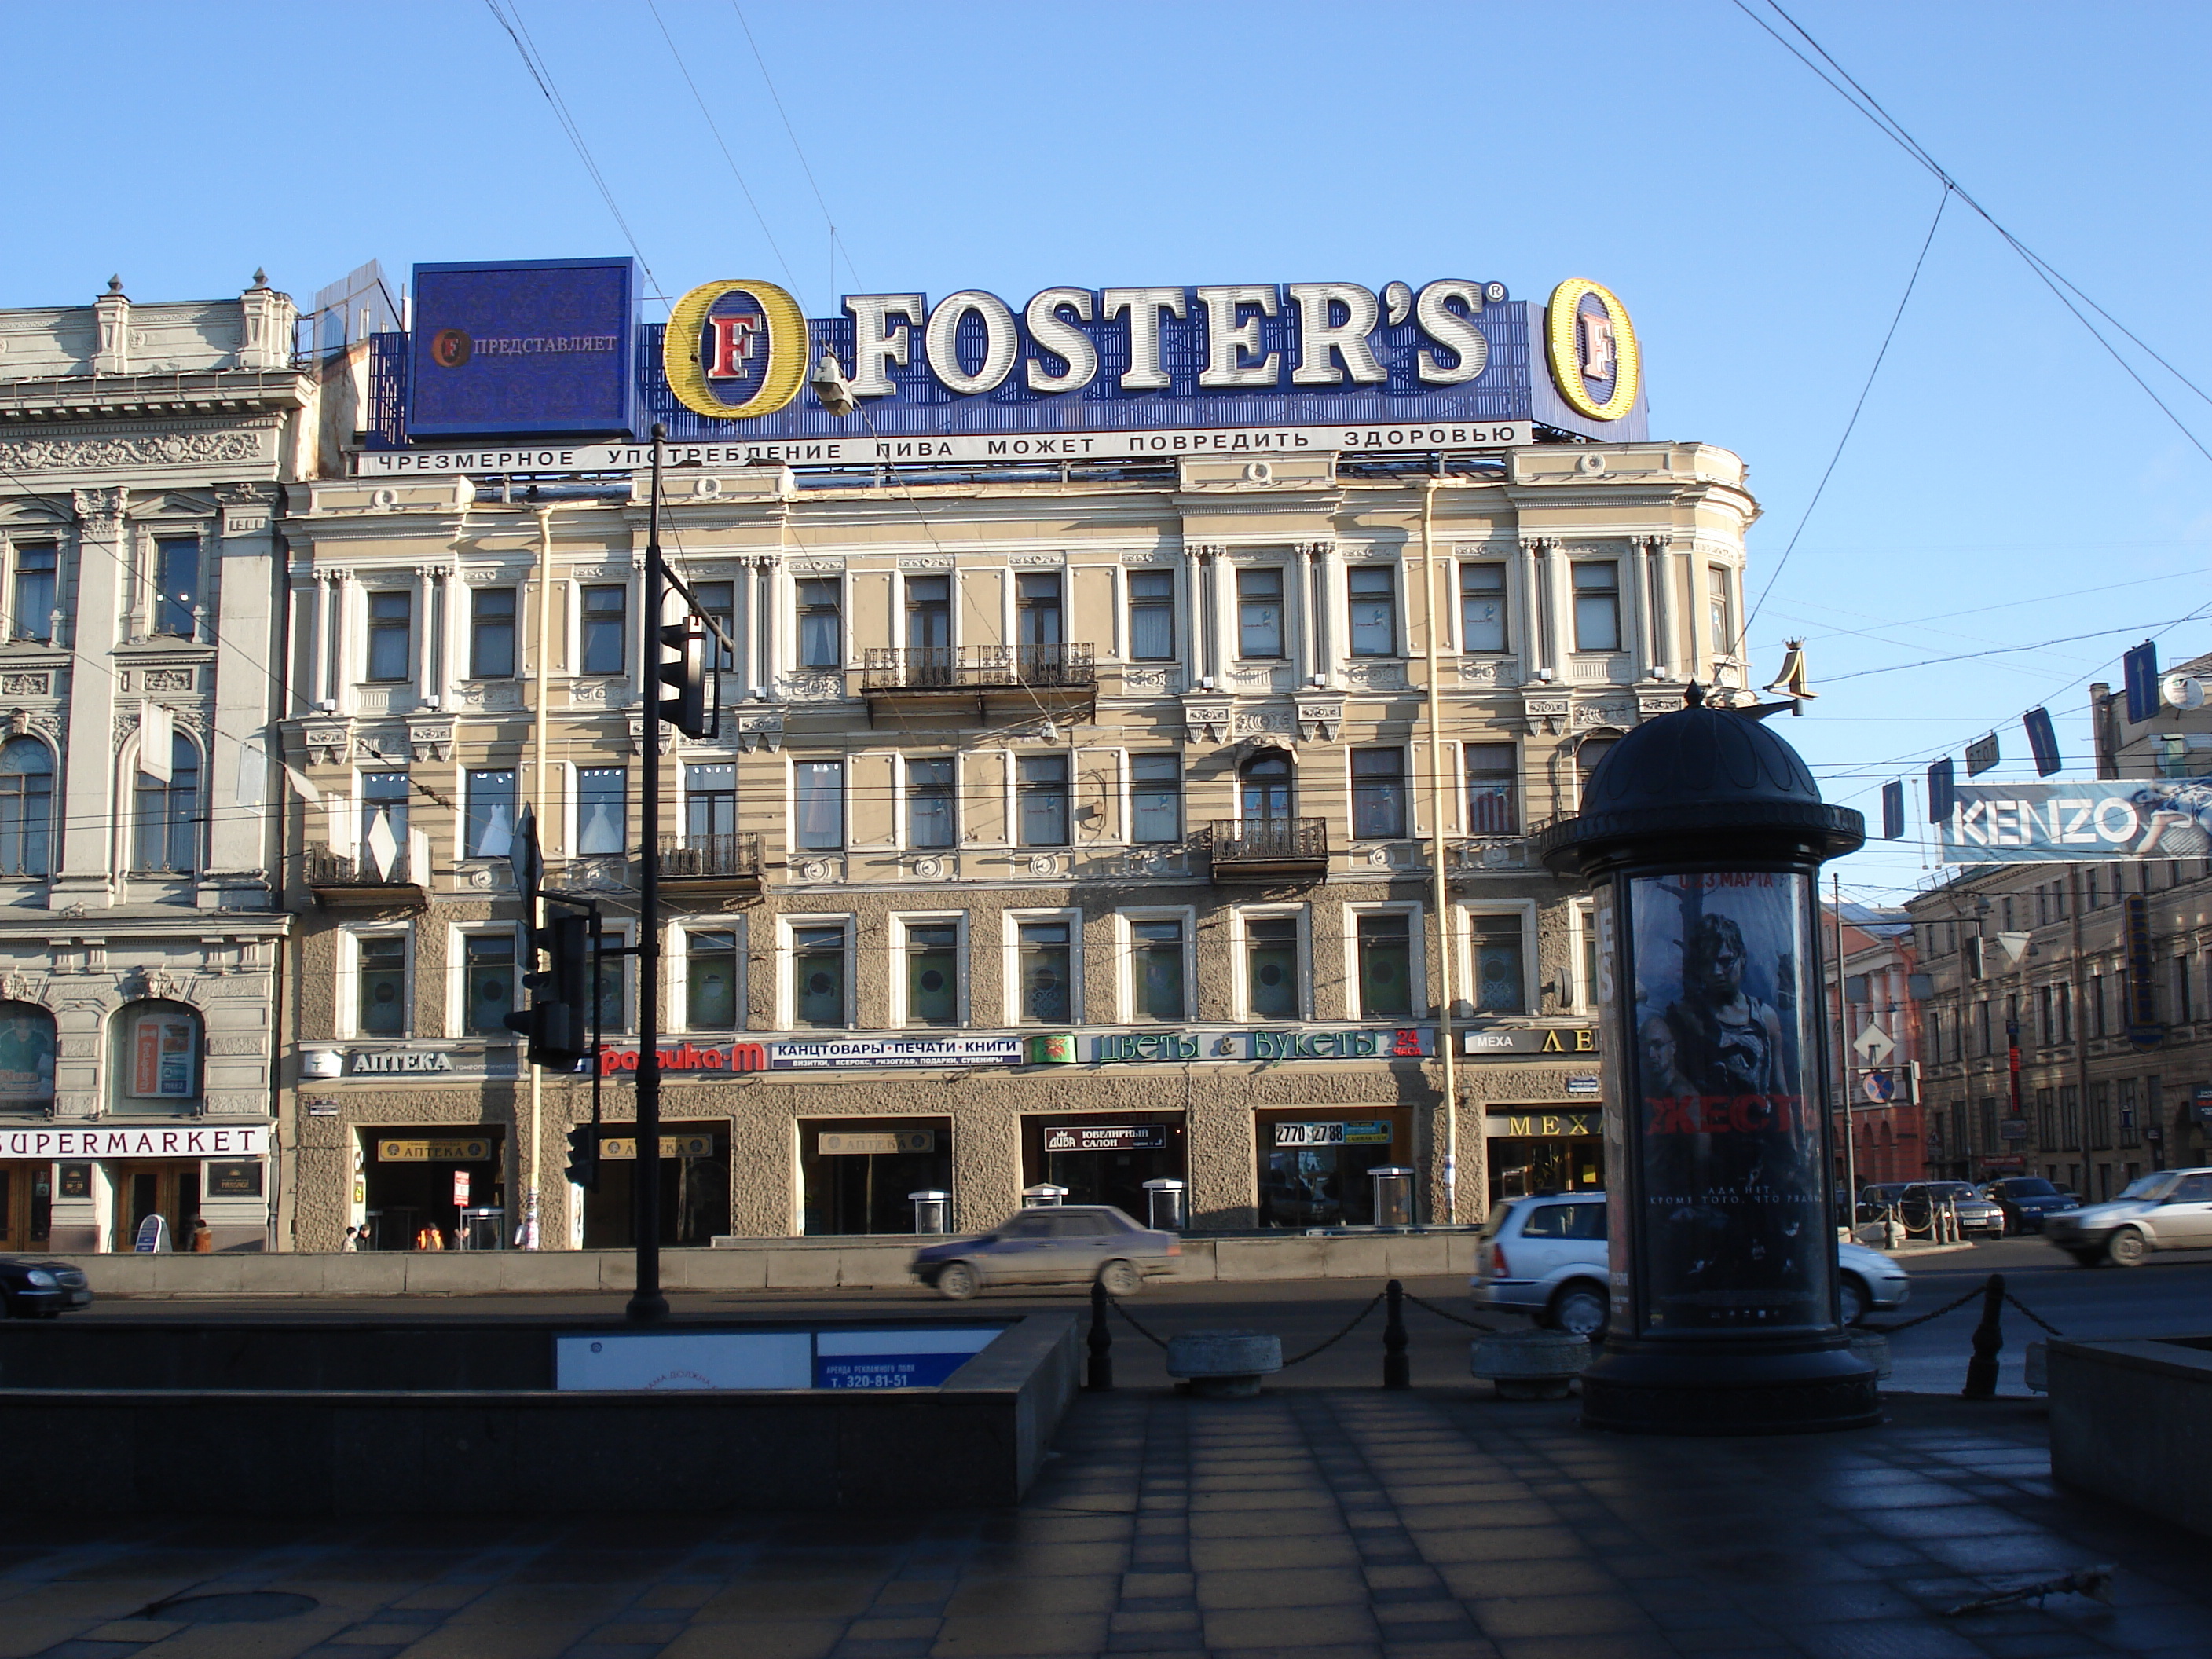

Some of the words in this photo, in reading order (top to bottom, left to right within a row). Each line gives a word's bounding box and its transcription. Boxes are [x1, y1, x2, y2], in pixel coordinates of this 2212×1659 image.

[842, 277, 1486, 397] FOSTER'S
[473, 335, 617, 356] ПРЕДСТАВЛЯЕТ
[379, 450, 574, 471] ЧРЕЗМЕРНОЕ
[876, 441, 954, 460] ПИВА
[987, 437, 1095, 455] МОЖЕТ
[1128, 431, 1309, 452] ПОВРЕДИТЬ
[1343, 426, 1515, 445] ЗДОРОВЬЮ
[1953, 797, 2138, 847] KENZO
[1396, 1030, 1419, 1046] 24
[1478, 1036, 1514, 1047] МЕХА
[778, 1042, 885, 1057] КАНЦТОВАРЫ
[895, 1042, 956, 1053] ПЕЧАТИ
[965, 1041, 1017, 1053] КНИГИ
[1219, 1037, 1236, 1055] &
[1392, 1046, 1423, 1056] ЧАСА
[353, 1052, 452, 1073] АПТЕКА
[835, 1058, 873, 1067] КСЕРОКС,
[875, 1057, 917, 1066] РИЗОГРАФ,
[920, 1057, 958, 1065] ПОДАРКИ,
[1082, 1128, 1149, 1139] ЮВЕЛИРНЫЙ
[0, 1130, 255, 1155] UPERMARKET
[846, 1139, 906, 1151] АПТЕКА
[1082, 1138, 1118, 1148] САЛОН
[404, 1147, 464, 1158] АПТЕКА
[826, 1365, 851, 1375] АРЕНДА
[854, 1364, 895, 1374] РЕКЛАМНОГО
[846, 1375, 907, 1388] 320-81-51
